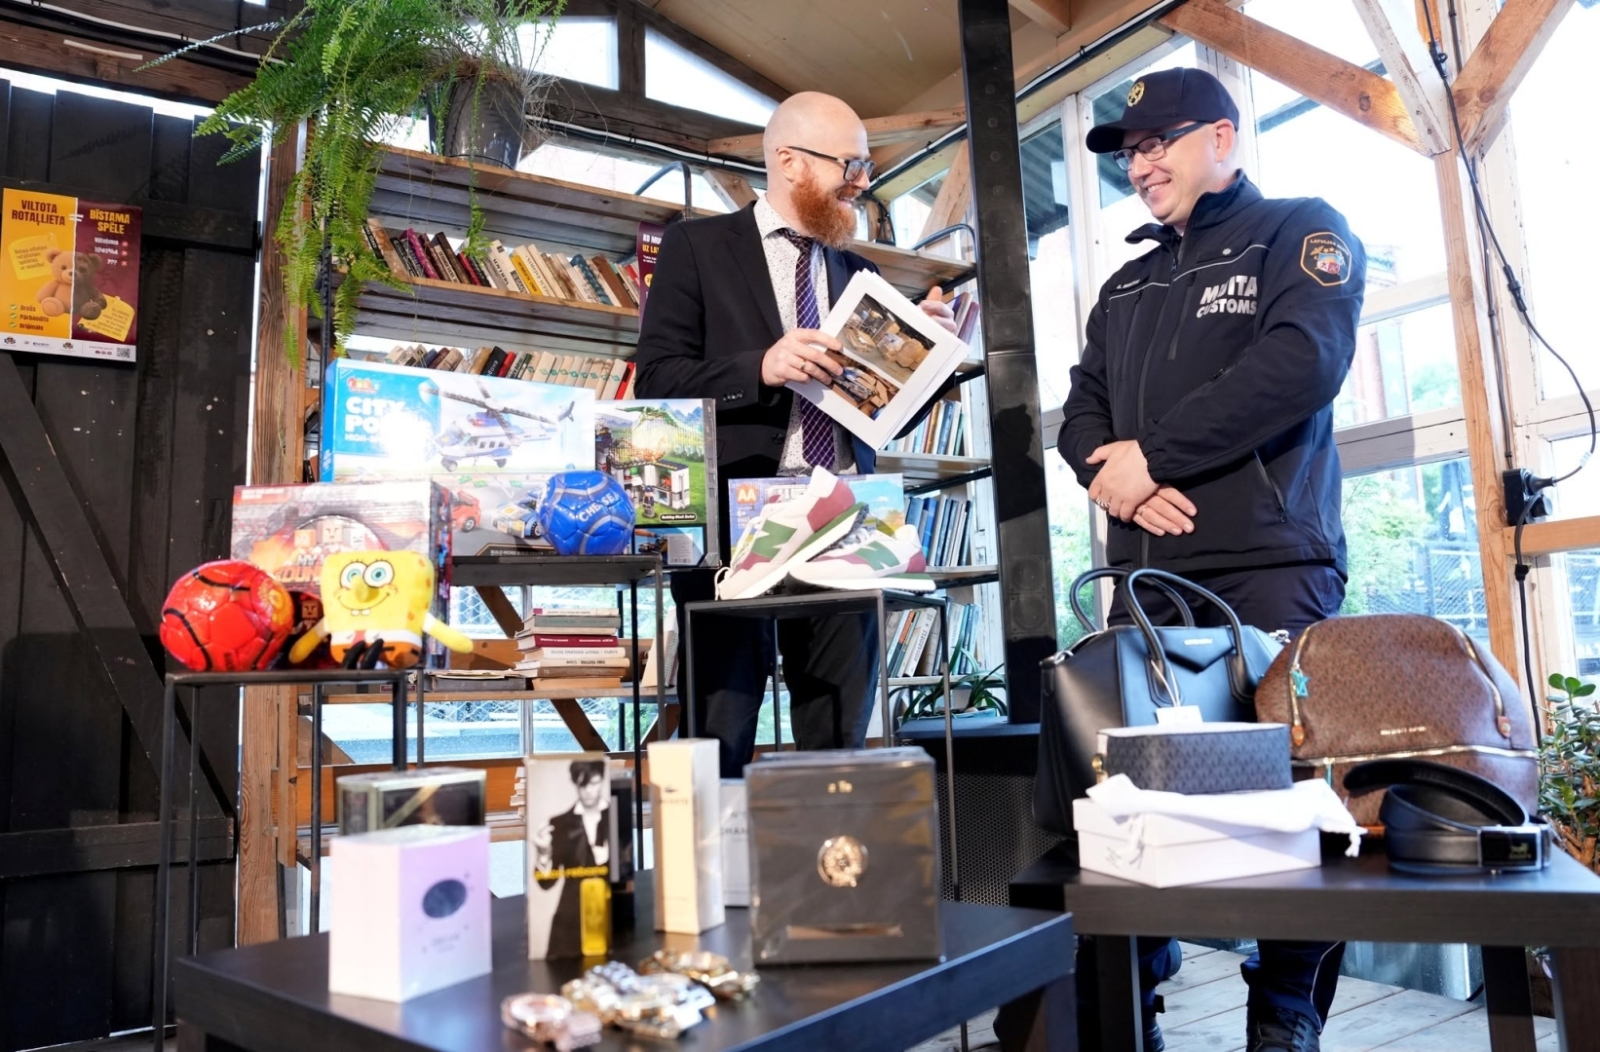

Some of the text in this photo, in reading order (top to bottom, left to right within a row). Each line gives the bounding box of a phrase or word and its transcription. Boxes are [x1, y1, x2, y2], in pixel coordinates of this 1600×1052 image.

[21, 199, 58, 213] VILTOTA
[11, 209, 66, 227] ROTAĻLIETA
[89, 208, 131, 225] BĪSTAMA
[97, 221, 125, 235] SPĒLE
[1196, 299, 1257, 318] CUSTOMS
[345, 396, 406, 415] CITY
